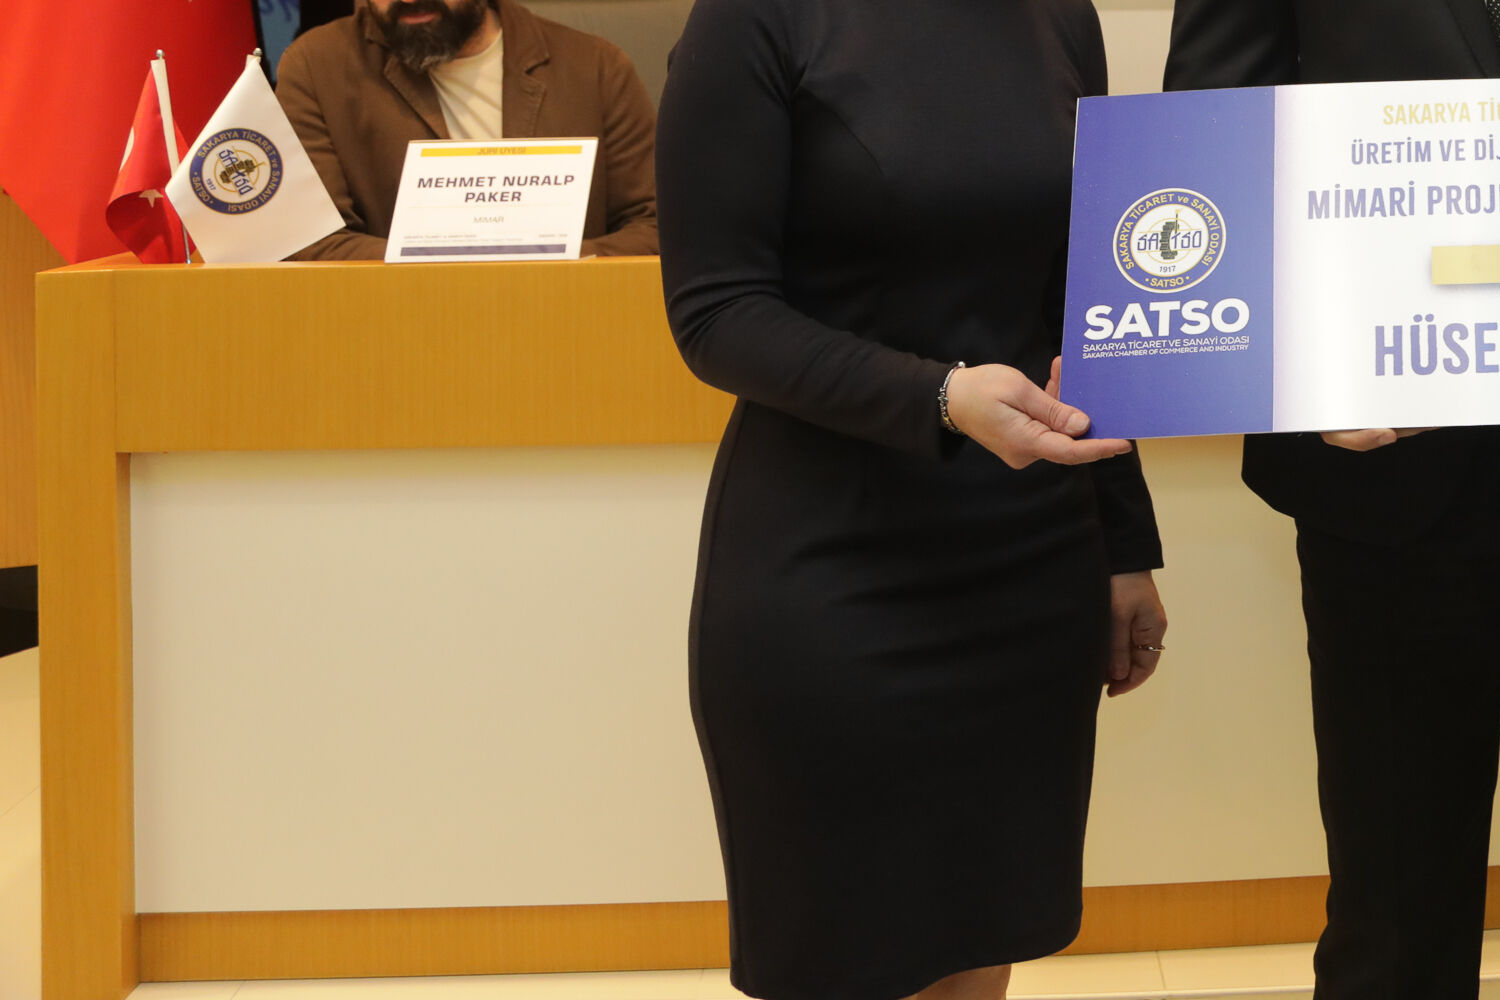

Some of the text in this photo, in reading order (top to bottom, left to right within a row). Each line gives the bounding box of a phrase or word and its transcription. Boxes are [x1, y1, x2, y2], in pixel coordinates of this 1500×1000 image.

[1382, 102, 1471, 126] SAKARYA
[197, 131, 240, 158] SAKARYA
[242, 130, 276, 156] TİCARET
[1350, 136, 1432, 165] ÜRETİM
[1439, 139, 1466, 162] VE
[417, 174, 575, 189] MEHMET NURALP
[228, 199, 259, 212] ODASI
[464, 191, 522, 203] PAKER
[1307, 180, 1415, 220] MİMARİ
[1119, 193, 1221, 270] SAKARYA TİCARET ve SANAYİ ODASI
[1159, 265, 1176, 273] 1917
[1150, 276, 1184, 288] SATSO
[1083, 297, 1250, 341] SATSO
[1082, 335, 1250, 353] SAKARYA TİCARET VE SANAYİ ODASI
[1082, 344, 1249, 359] SAKARYA CHAMBER OF COMMERCE AND INDUSTRY
